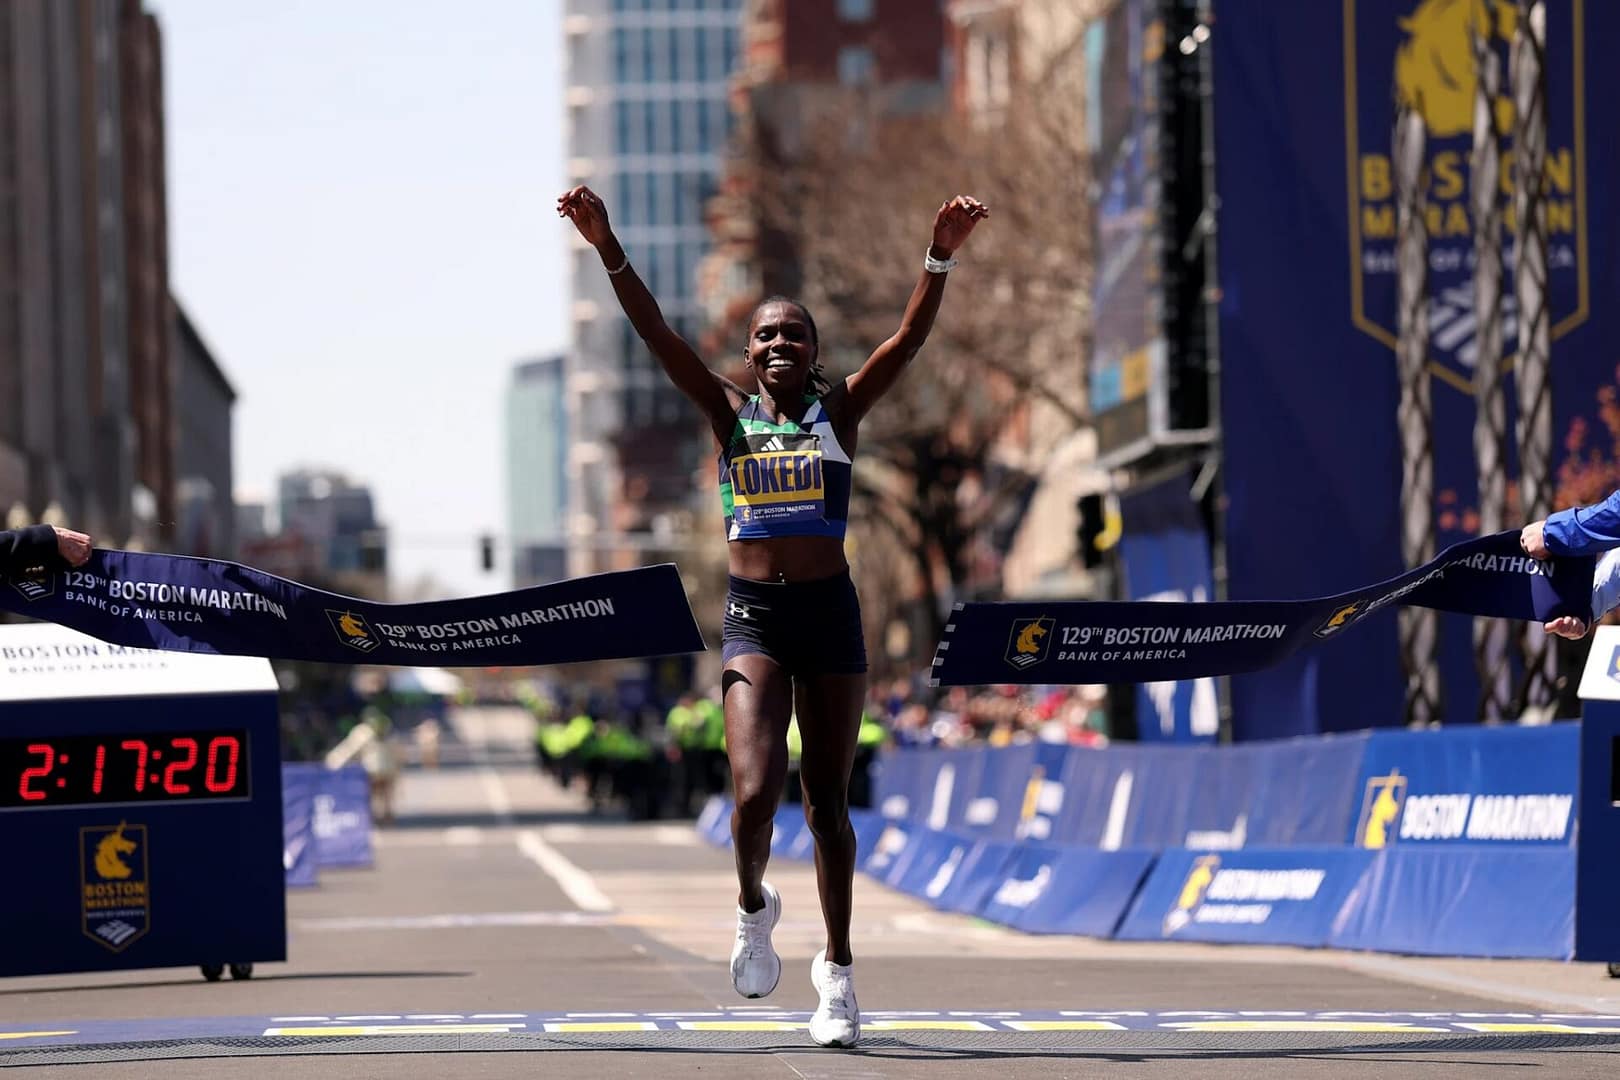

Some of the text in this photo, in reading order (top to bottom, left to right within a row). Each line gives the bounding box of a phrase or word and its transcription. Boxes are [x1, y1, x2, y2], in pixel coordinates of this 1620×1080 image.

[731, 455, 822, 495] LOKEDI
[764, 506, 786, 514] BOSTON
[1445, 552, 1555, 578] ARATHON
[64, 571, 287, 620] 129TH BOSTON MARATHON
[65, 591, 203, 623] BANK OF AMERICA
[375, 598, 615, 639] 129TH BOSTON MARATHON
[388, 634, 522, 652] BANK OF AMERICA
[1062, 624, 1287, 645] 129TH BOSTON MARATHON
[1057, 649, 1187, 661] BANK OF AMERICA
[19, 736, 240, 800] 2:17:20
